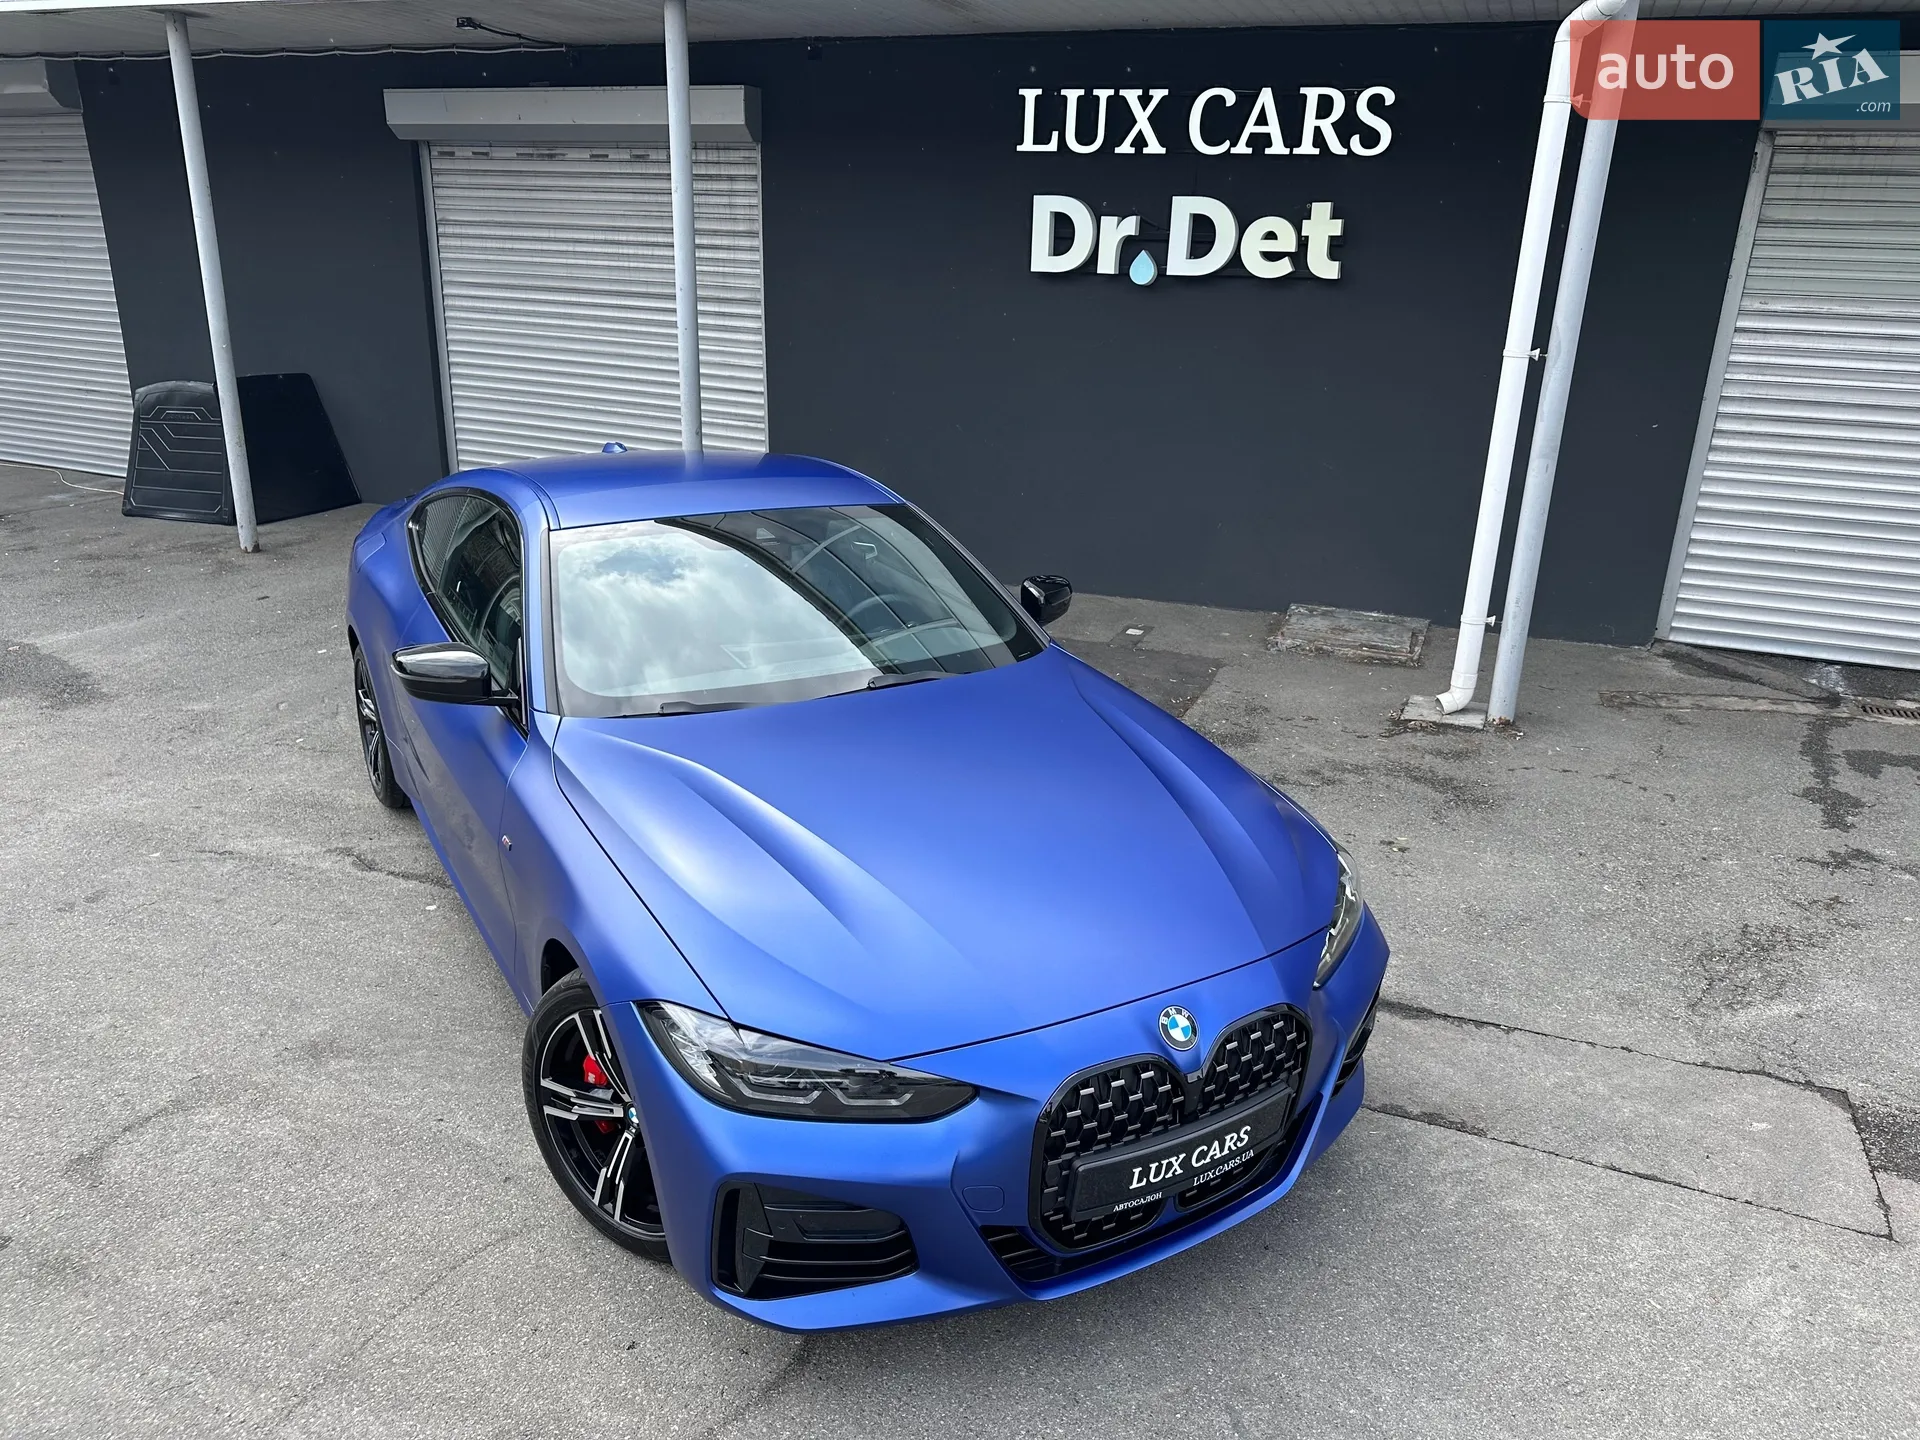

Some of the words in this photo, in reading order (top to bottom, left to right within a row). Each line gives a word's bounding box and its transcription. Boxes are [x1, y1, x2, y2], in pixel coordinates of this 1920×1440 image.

[1016, 88, 1169, 154] LUX
[1188, 86, 1396, 157] CARS
[1129, 1153, 1187, 1190] LUX
[1191, 1125, 1251, 1168] CARS
[1193, 1149, 1254, 1187] LUX.CARS.UA
[1113, 1191, 1162, 1212] АВТОСАЛОН
